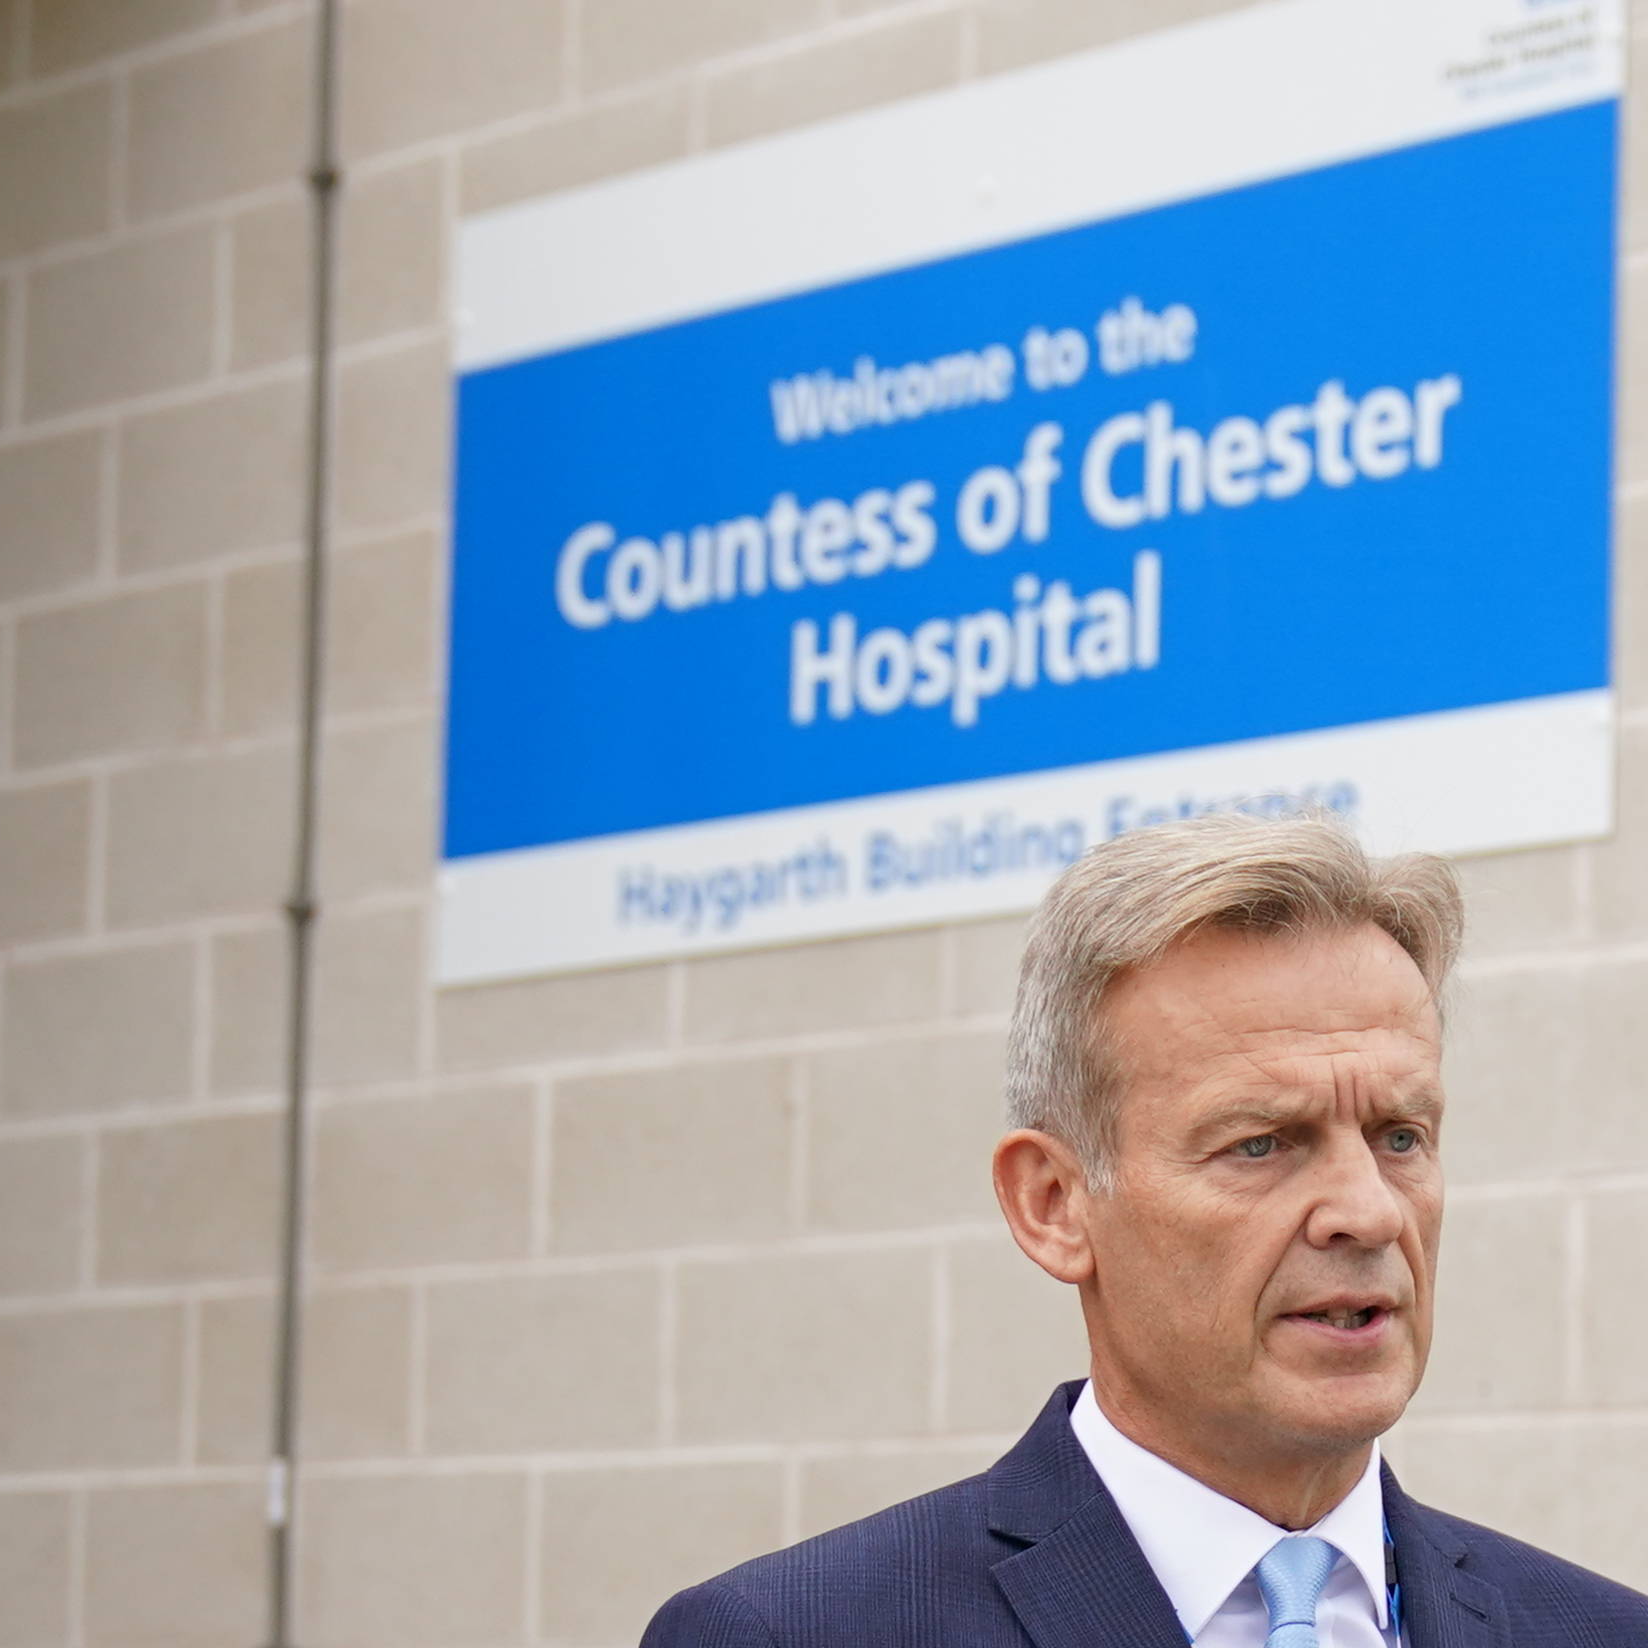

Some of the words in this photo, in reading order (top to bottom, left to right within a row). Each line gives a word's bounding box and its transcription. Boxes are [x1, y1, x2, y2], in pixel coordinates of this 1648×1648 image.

[770, 344, 1014, 444] Welcome
[1023, 325, 1088, 391] to
[1097, 296, 1197, 375] the
[555, 480, 936, 630] Countess
[956, 420, 1064, 555] of
[1081, 373, 1461, 528] Chester
[789, 549, 1162, 727] Hospital
[619, 836, 848, 934] Haygarth
[866, 810, 1085, 892] Building
